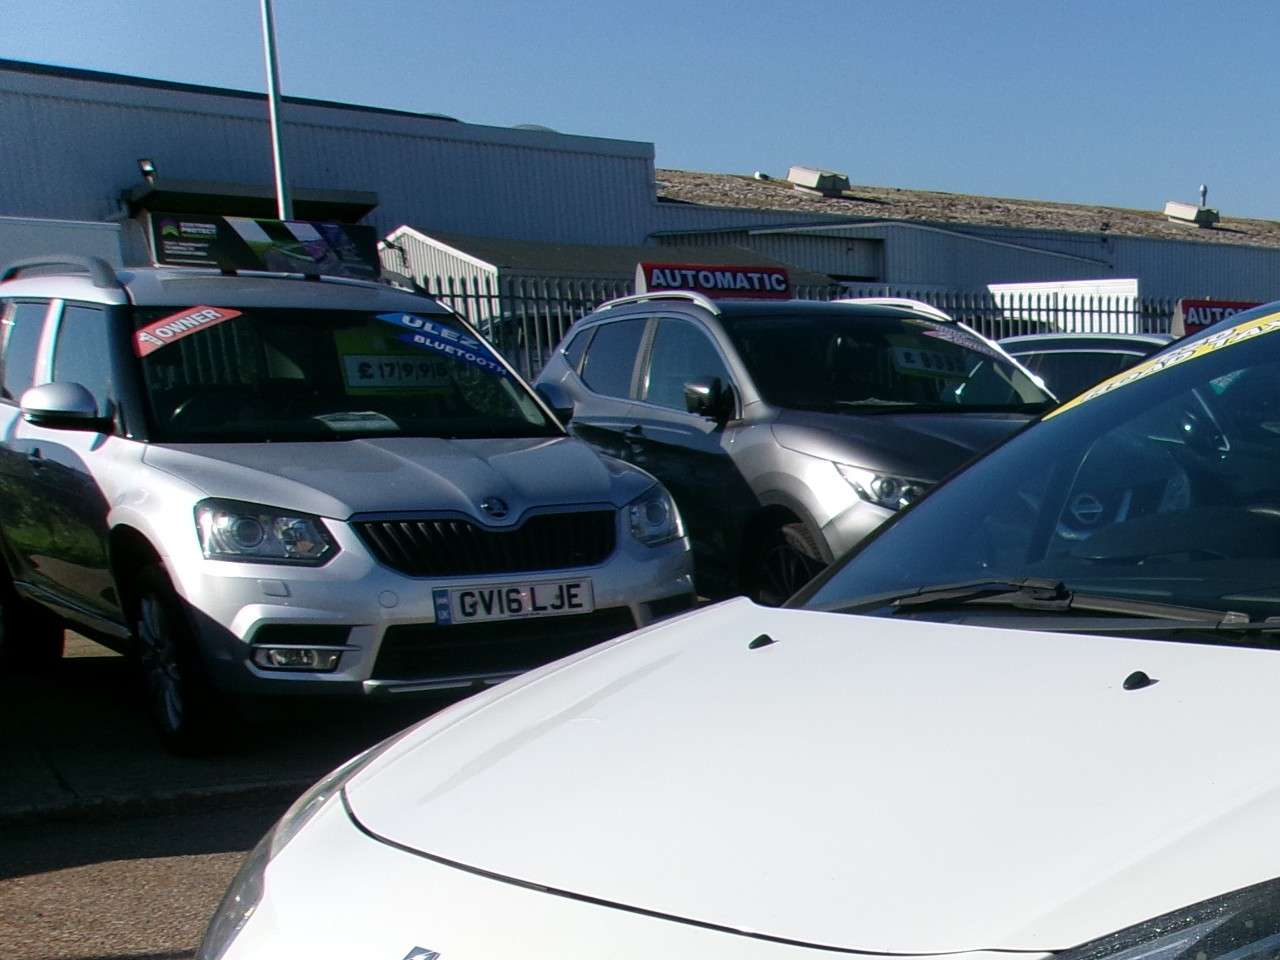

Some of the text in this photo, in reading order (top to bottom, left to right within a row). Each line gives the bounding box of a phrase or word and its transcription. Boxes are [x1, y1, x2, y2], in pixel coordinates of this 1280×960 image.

[651, 268, 787, 291] AUTOMATIC
[155, 309, 222, 337] OWNER
[401, 314, 479, 350] ULEZ
[413, 334, 508, 376] BLUETOOTH
[459, 588, 523, 617] GV16
[530, 583, 582, 612] LJE
